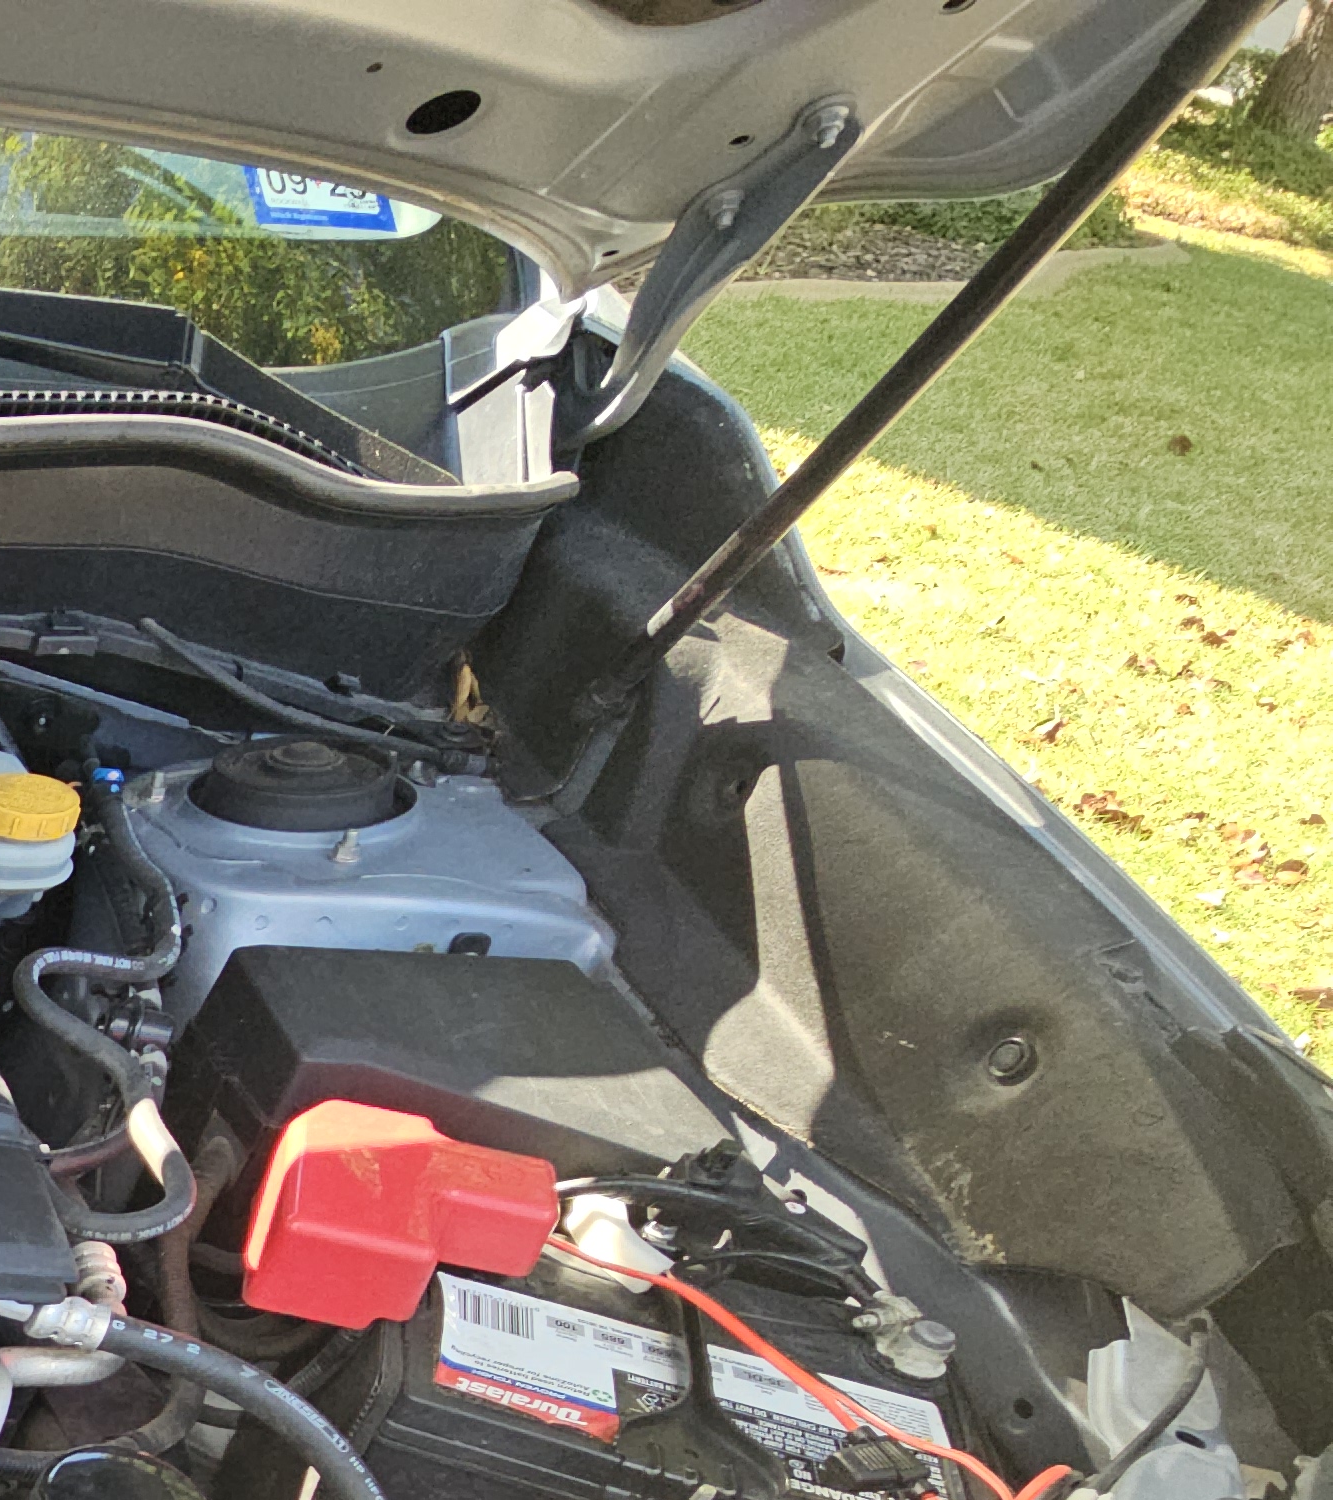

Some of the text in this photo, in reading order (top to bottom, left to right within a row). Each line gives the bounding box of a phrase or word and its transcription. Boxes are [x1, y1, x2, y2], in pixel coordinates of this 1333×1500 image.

[553, 1318, 578, 1332] 100
[515, 1380, 567, 1400] PROVEN
[455, 1377, 588, 1426] Duralast
